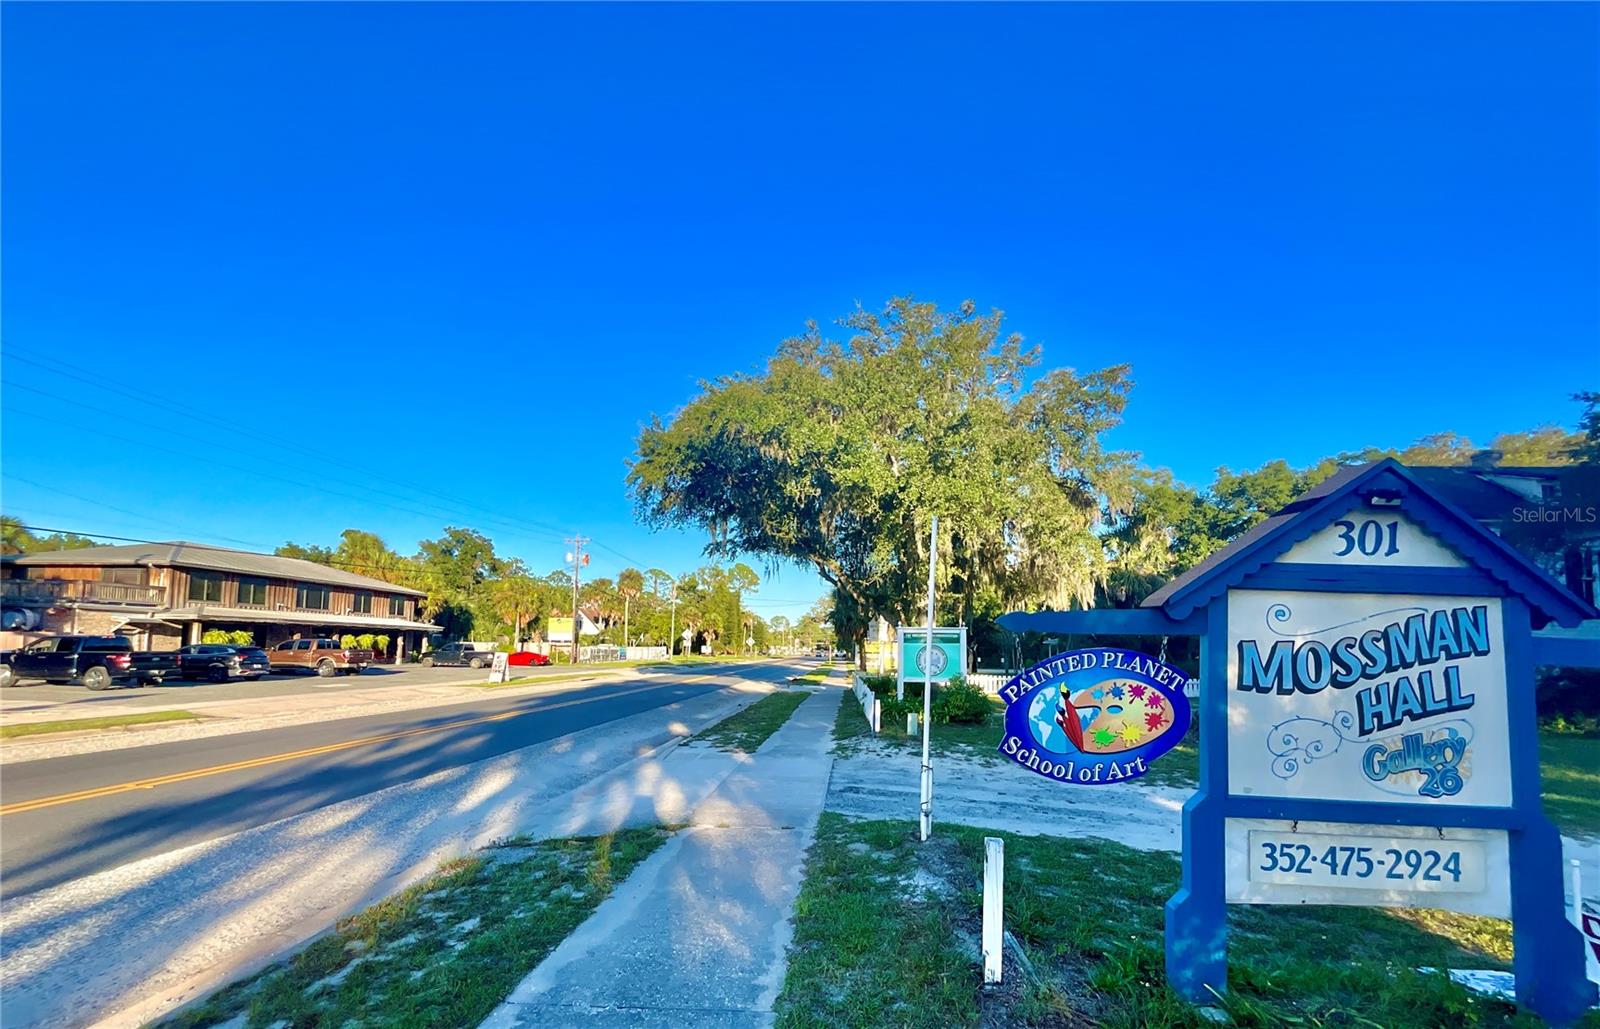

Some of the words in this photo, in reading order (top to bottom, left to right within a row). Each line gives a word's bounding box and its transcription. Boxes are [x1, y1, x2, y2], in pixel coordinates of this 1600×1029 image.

[1334, 519, 1400, 557] 301
[1237, 605, 1490, 696] MOSSMAN
[1004, 653, 1098, 704] PAINTED
[1102, 651, 1185, 692] PLANET
[1355, 665, 1476, 738] HALL
[1003, 735, 1074, 780] School
[1079, 763, 1104, 782] of
[1106, 755, 1148, 781] Art
[1362, 732, 1467, 782] Gallery
[1417, 766, 1464, 799] 26
